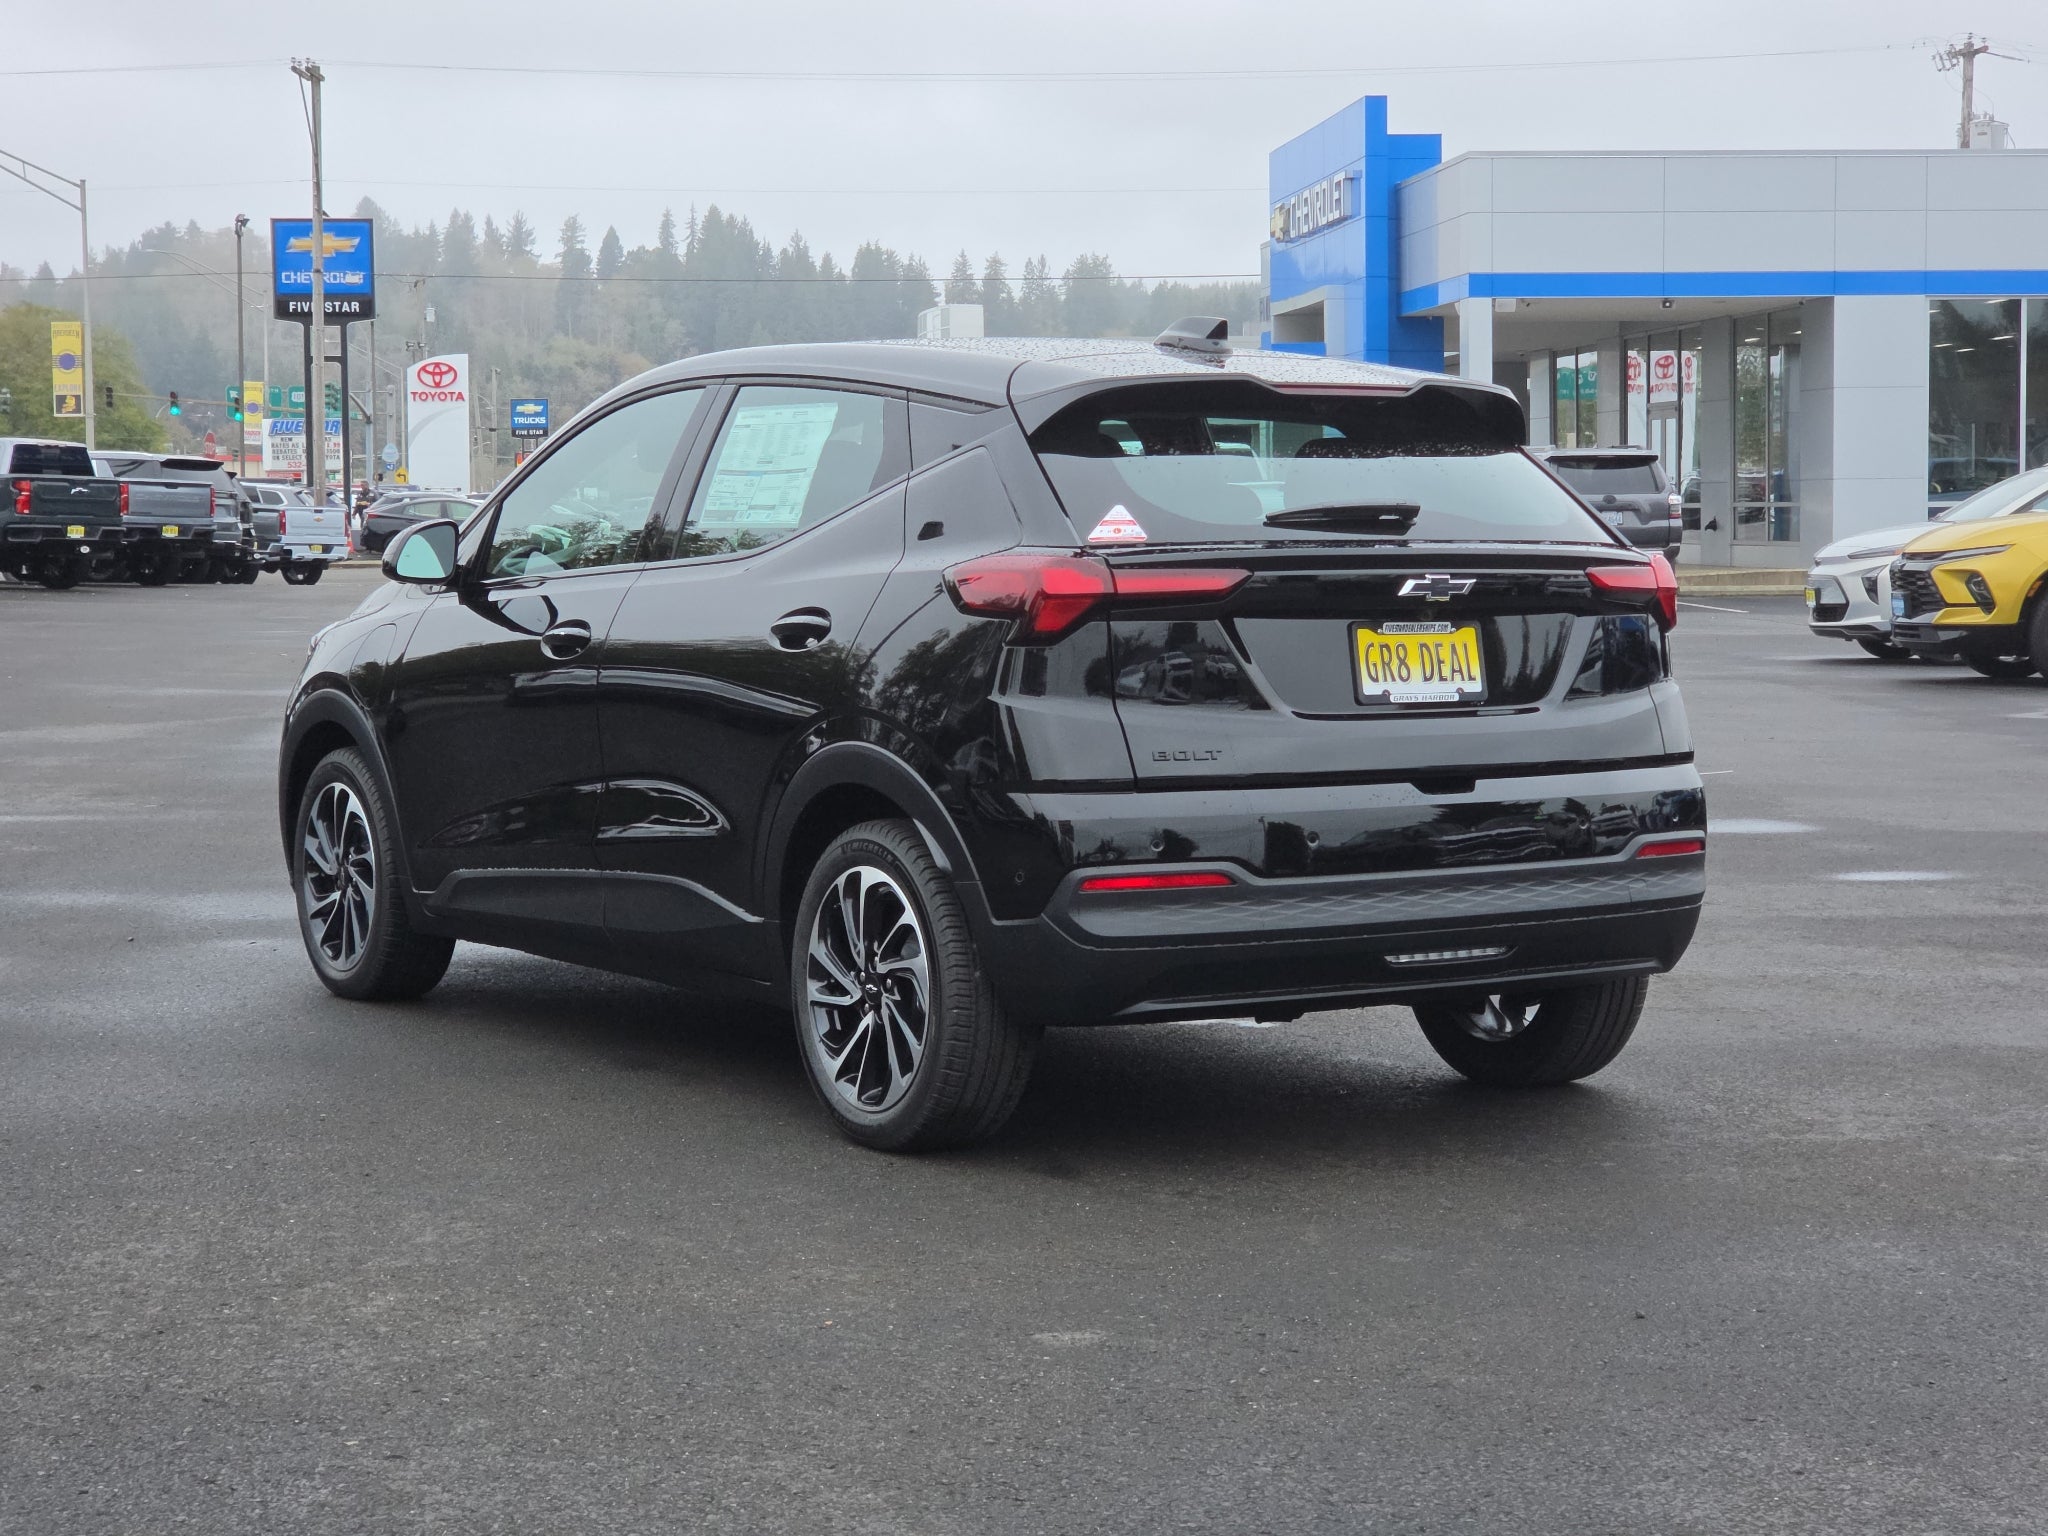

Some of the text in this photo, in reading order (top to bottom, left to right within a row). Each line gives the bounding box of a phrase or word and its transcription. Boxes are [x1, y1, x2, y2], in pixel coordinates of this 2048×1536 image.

[1289, 170, 1346, 238] CHEVROLET
[289, 301, 360, 313] FIV STAR
[410, 391, 465, 402] TOYOTA
[513, 416, 546, 424] TRUCKS
[269, 420, 304, 436] FIVE
[1364, 641, 1477, 683] GR8 DEAL
[1151, 750, 1222, 761] BOLT
